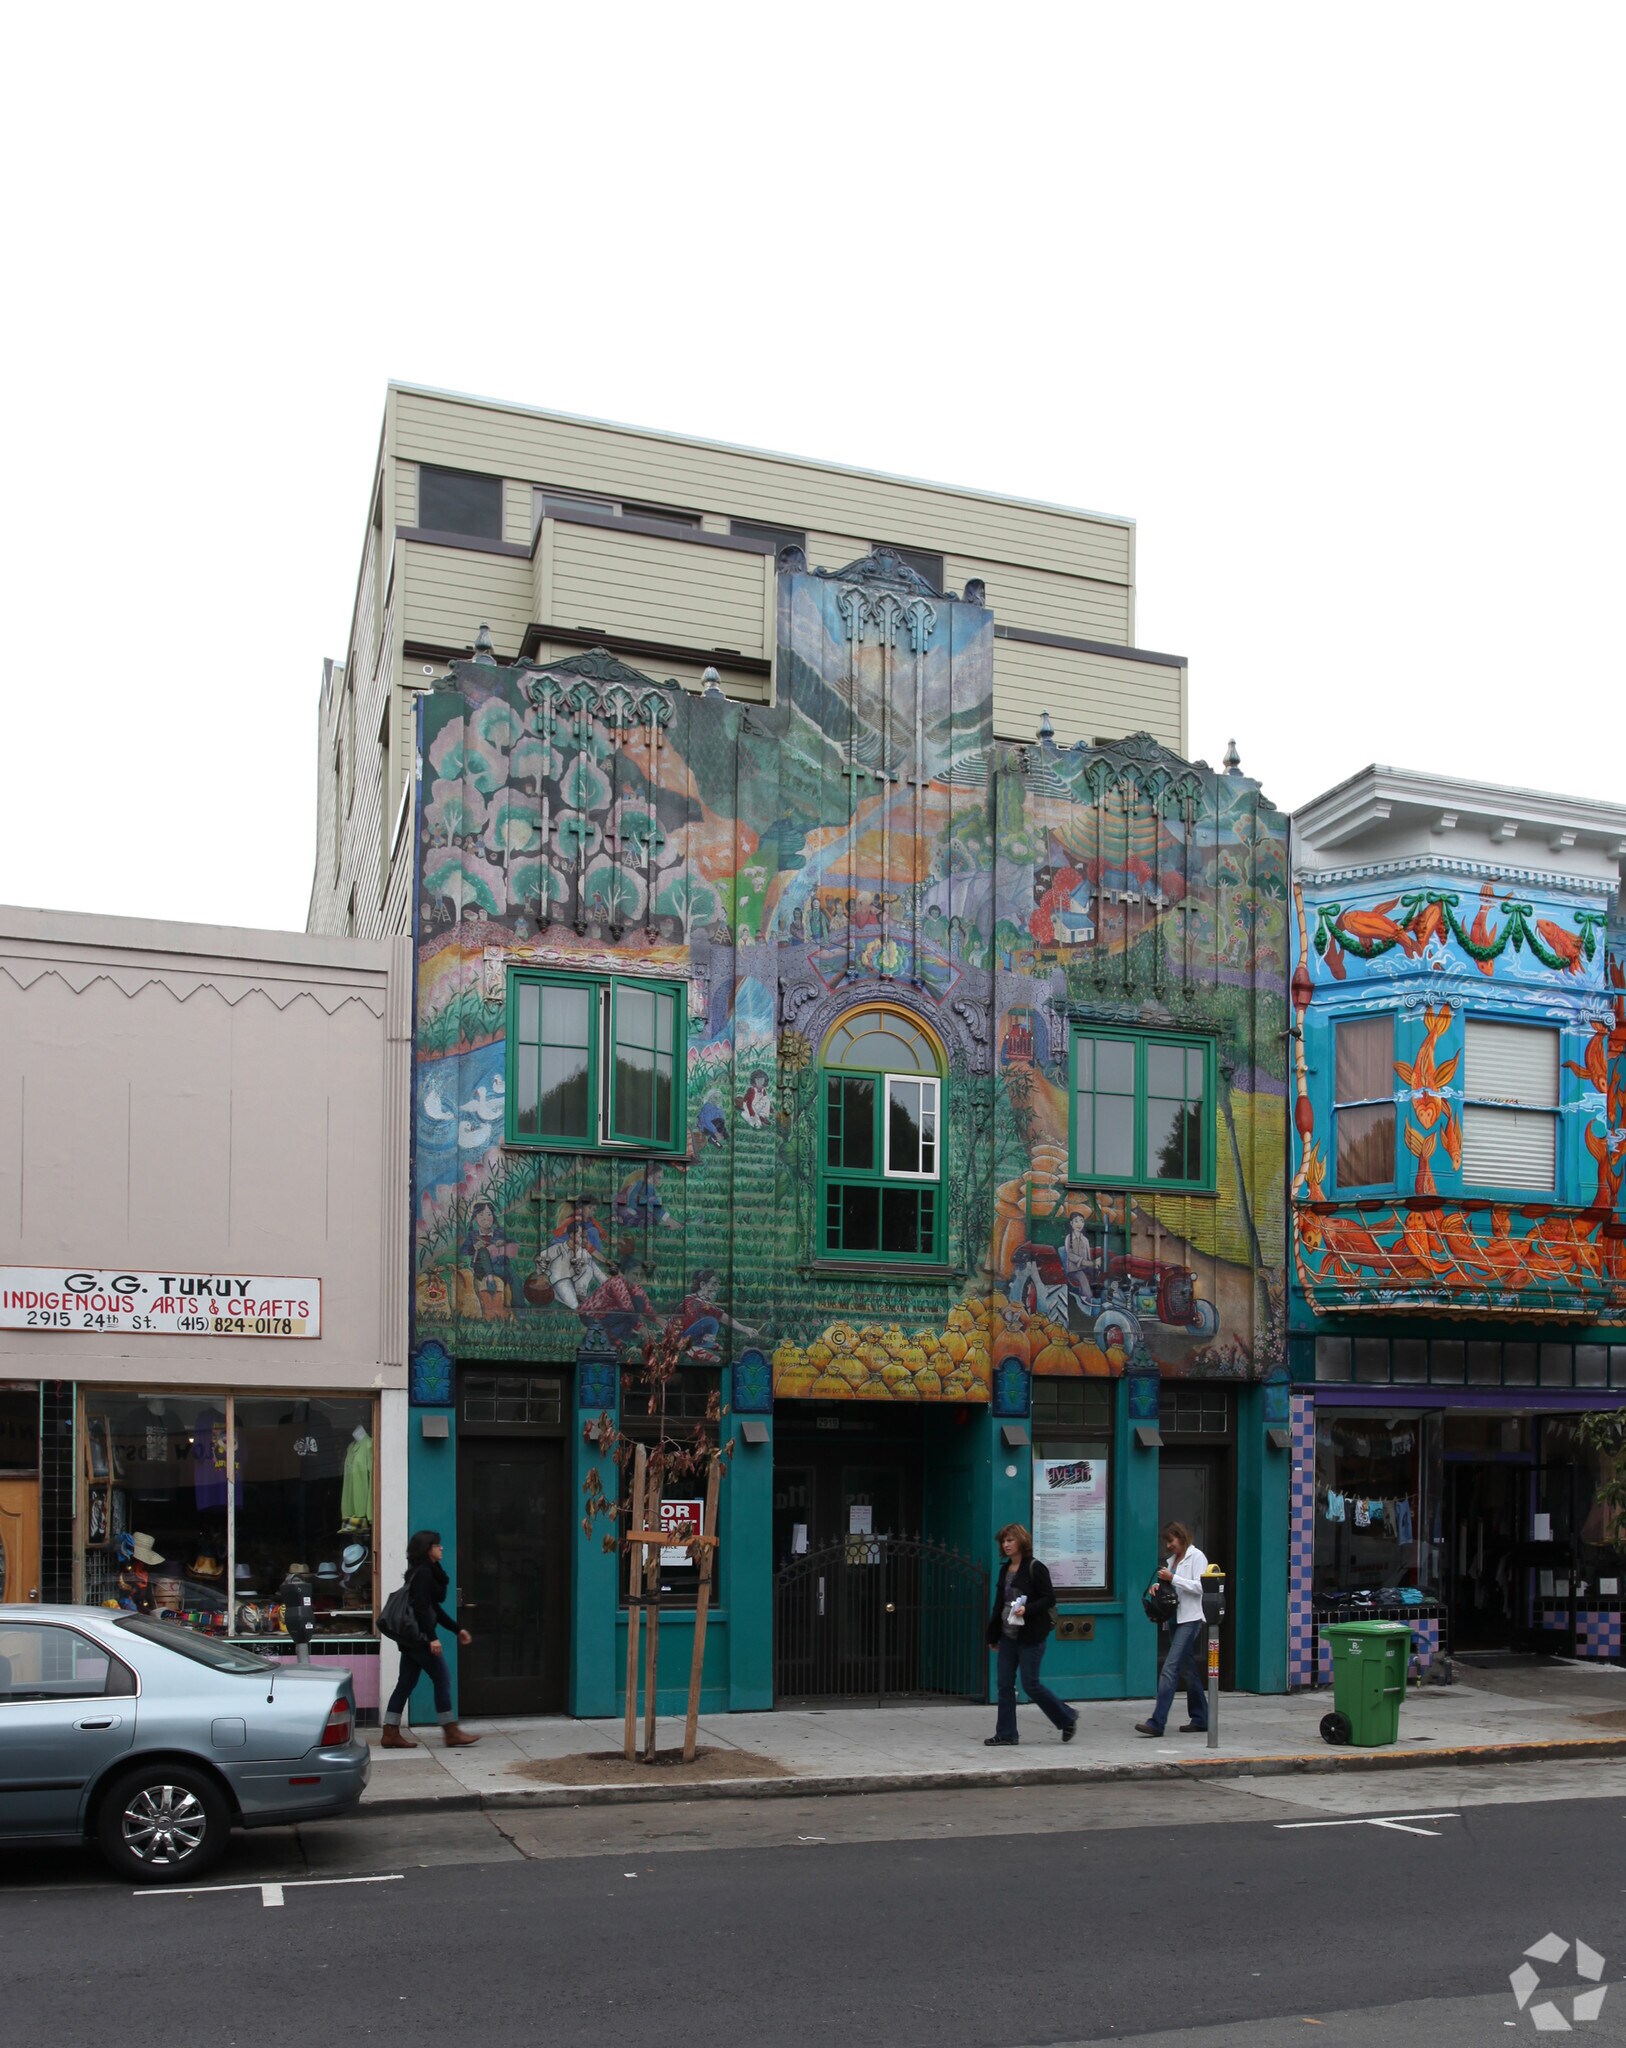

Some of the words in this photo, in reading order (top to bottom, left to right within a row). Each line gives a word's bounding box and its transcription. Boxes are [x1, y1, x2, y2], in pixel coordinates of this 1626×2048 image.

[159, 1277, 251, 1297] TUKUY
[3, 1290, 135, 1313] INDIGENOUS
[149, 1296, 199, 1315] ARTS
[208, 1298, 219, 1316] &
[227, 1298, 309, 1318] CRAFTS
[27, 1311, 71, 1327] 2915
[132, 1315, 157, 1330] St.
[176, 1316, 209, 1331] (415)
[214, 1317, 292, 1335] 824-0178
[661, 1505, 690, 1518] OR
